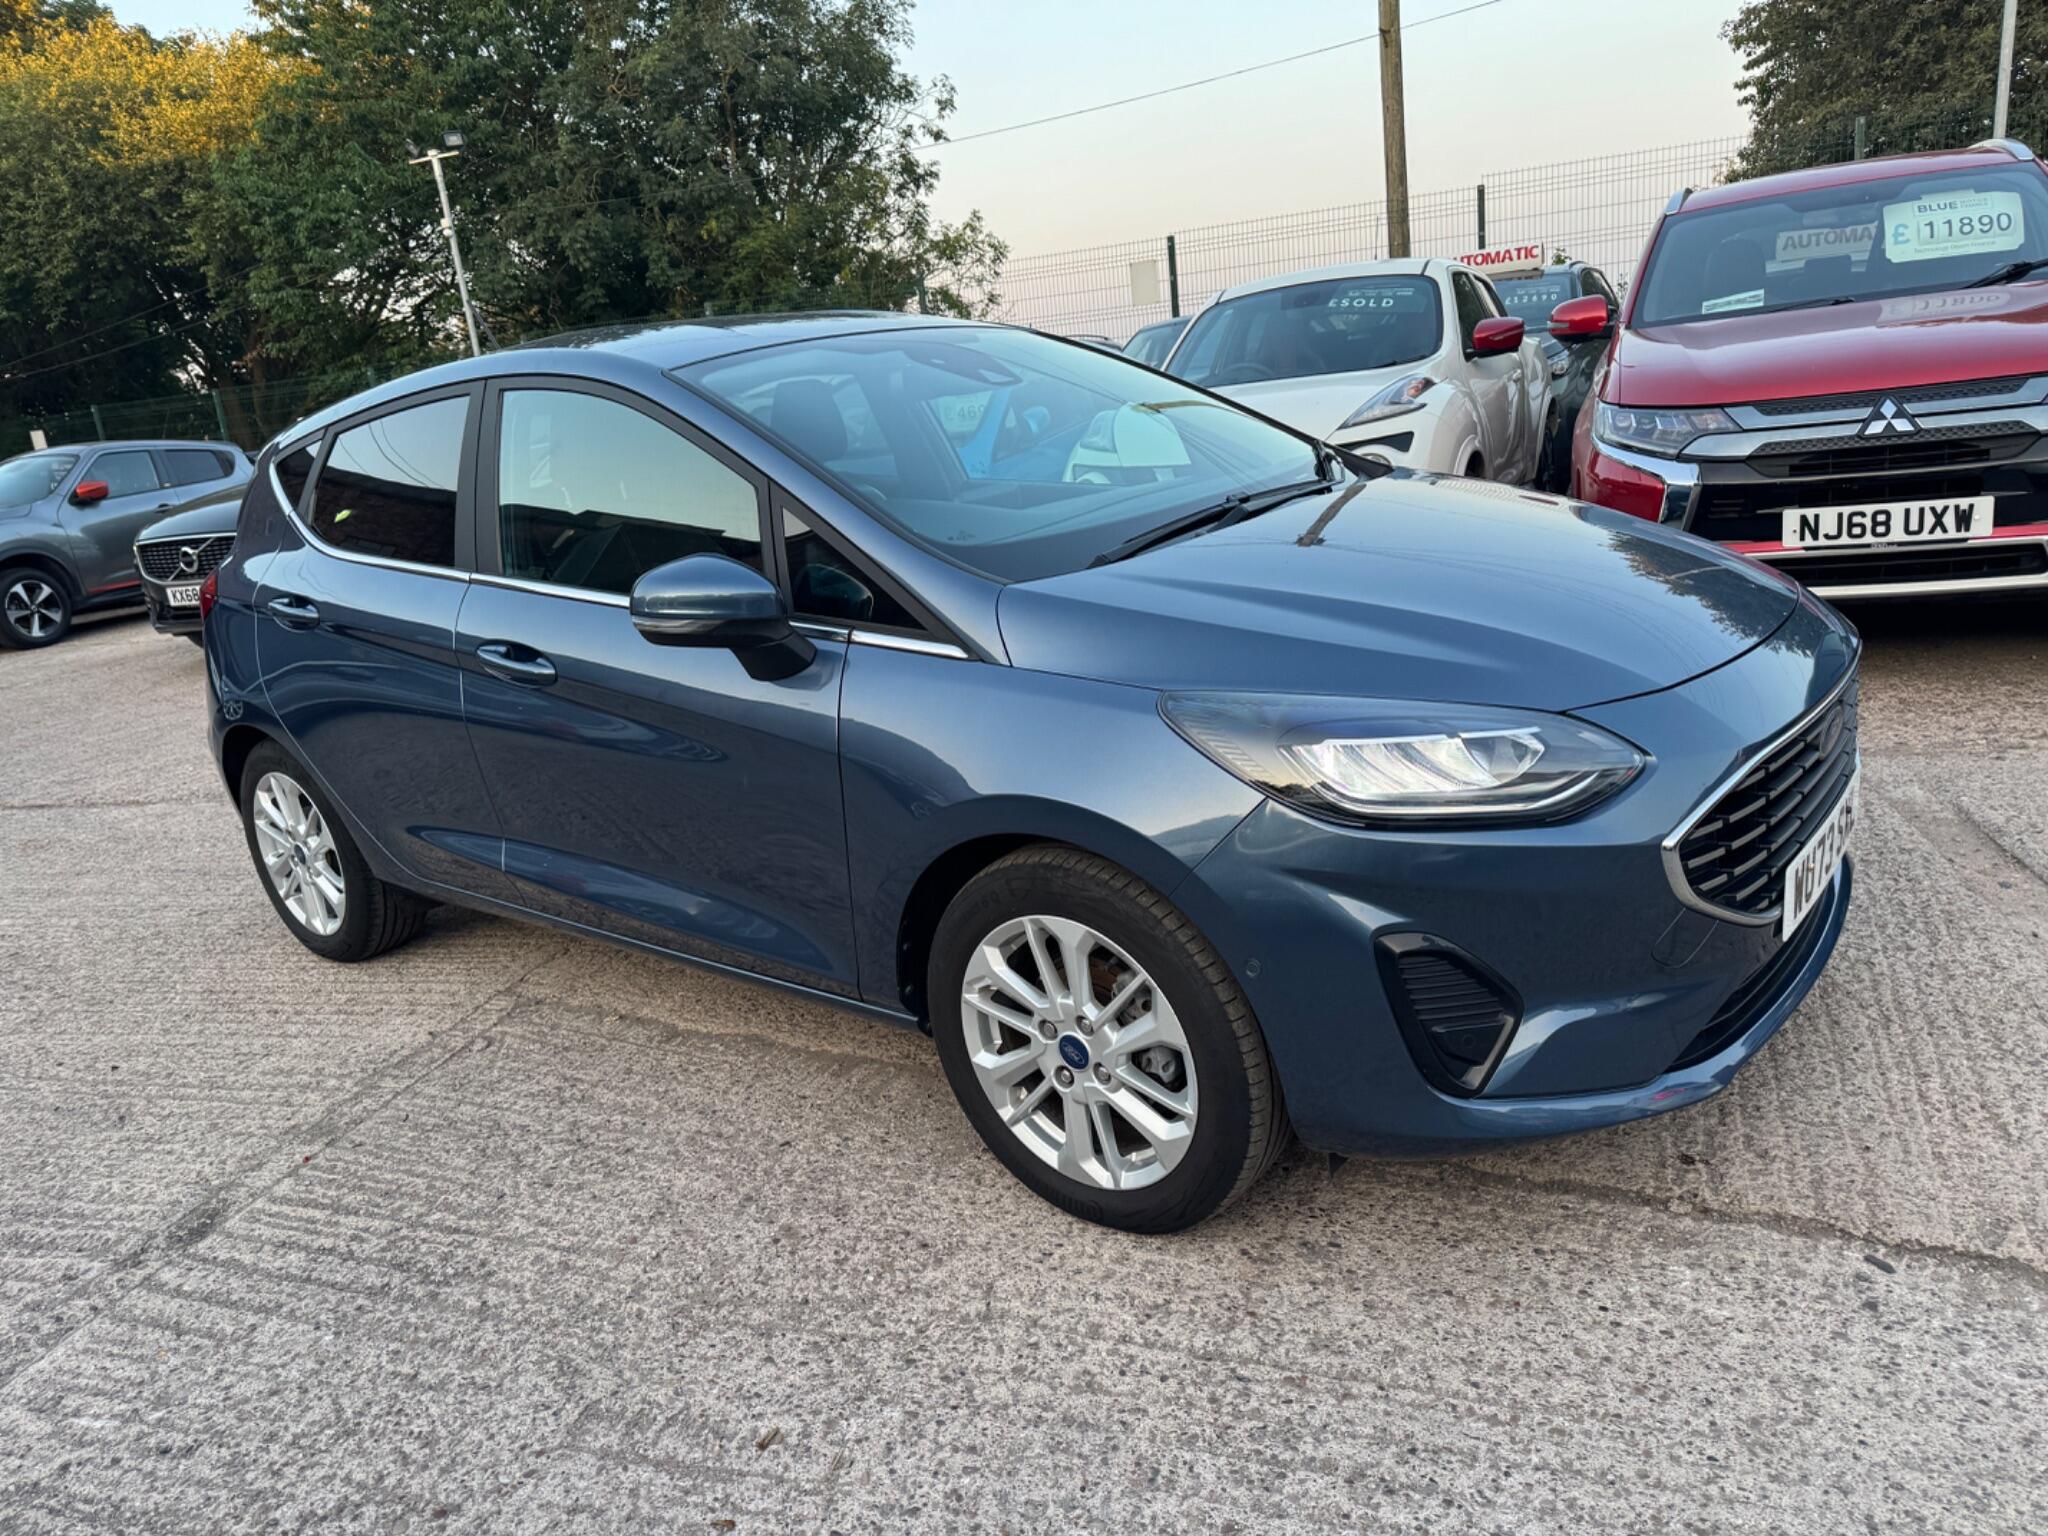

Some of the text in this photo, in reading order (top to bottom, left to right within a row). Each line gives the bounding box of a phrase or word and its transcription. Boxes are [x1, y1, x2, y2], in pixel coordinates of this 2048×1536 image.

[1917, 201, 1959, 213] BLUE
[1924, 212, 2012, 239] 11890
[1799, 503, 1975, 542] NJ68 UXW
[170, 588, 199, 602] KX68
